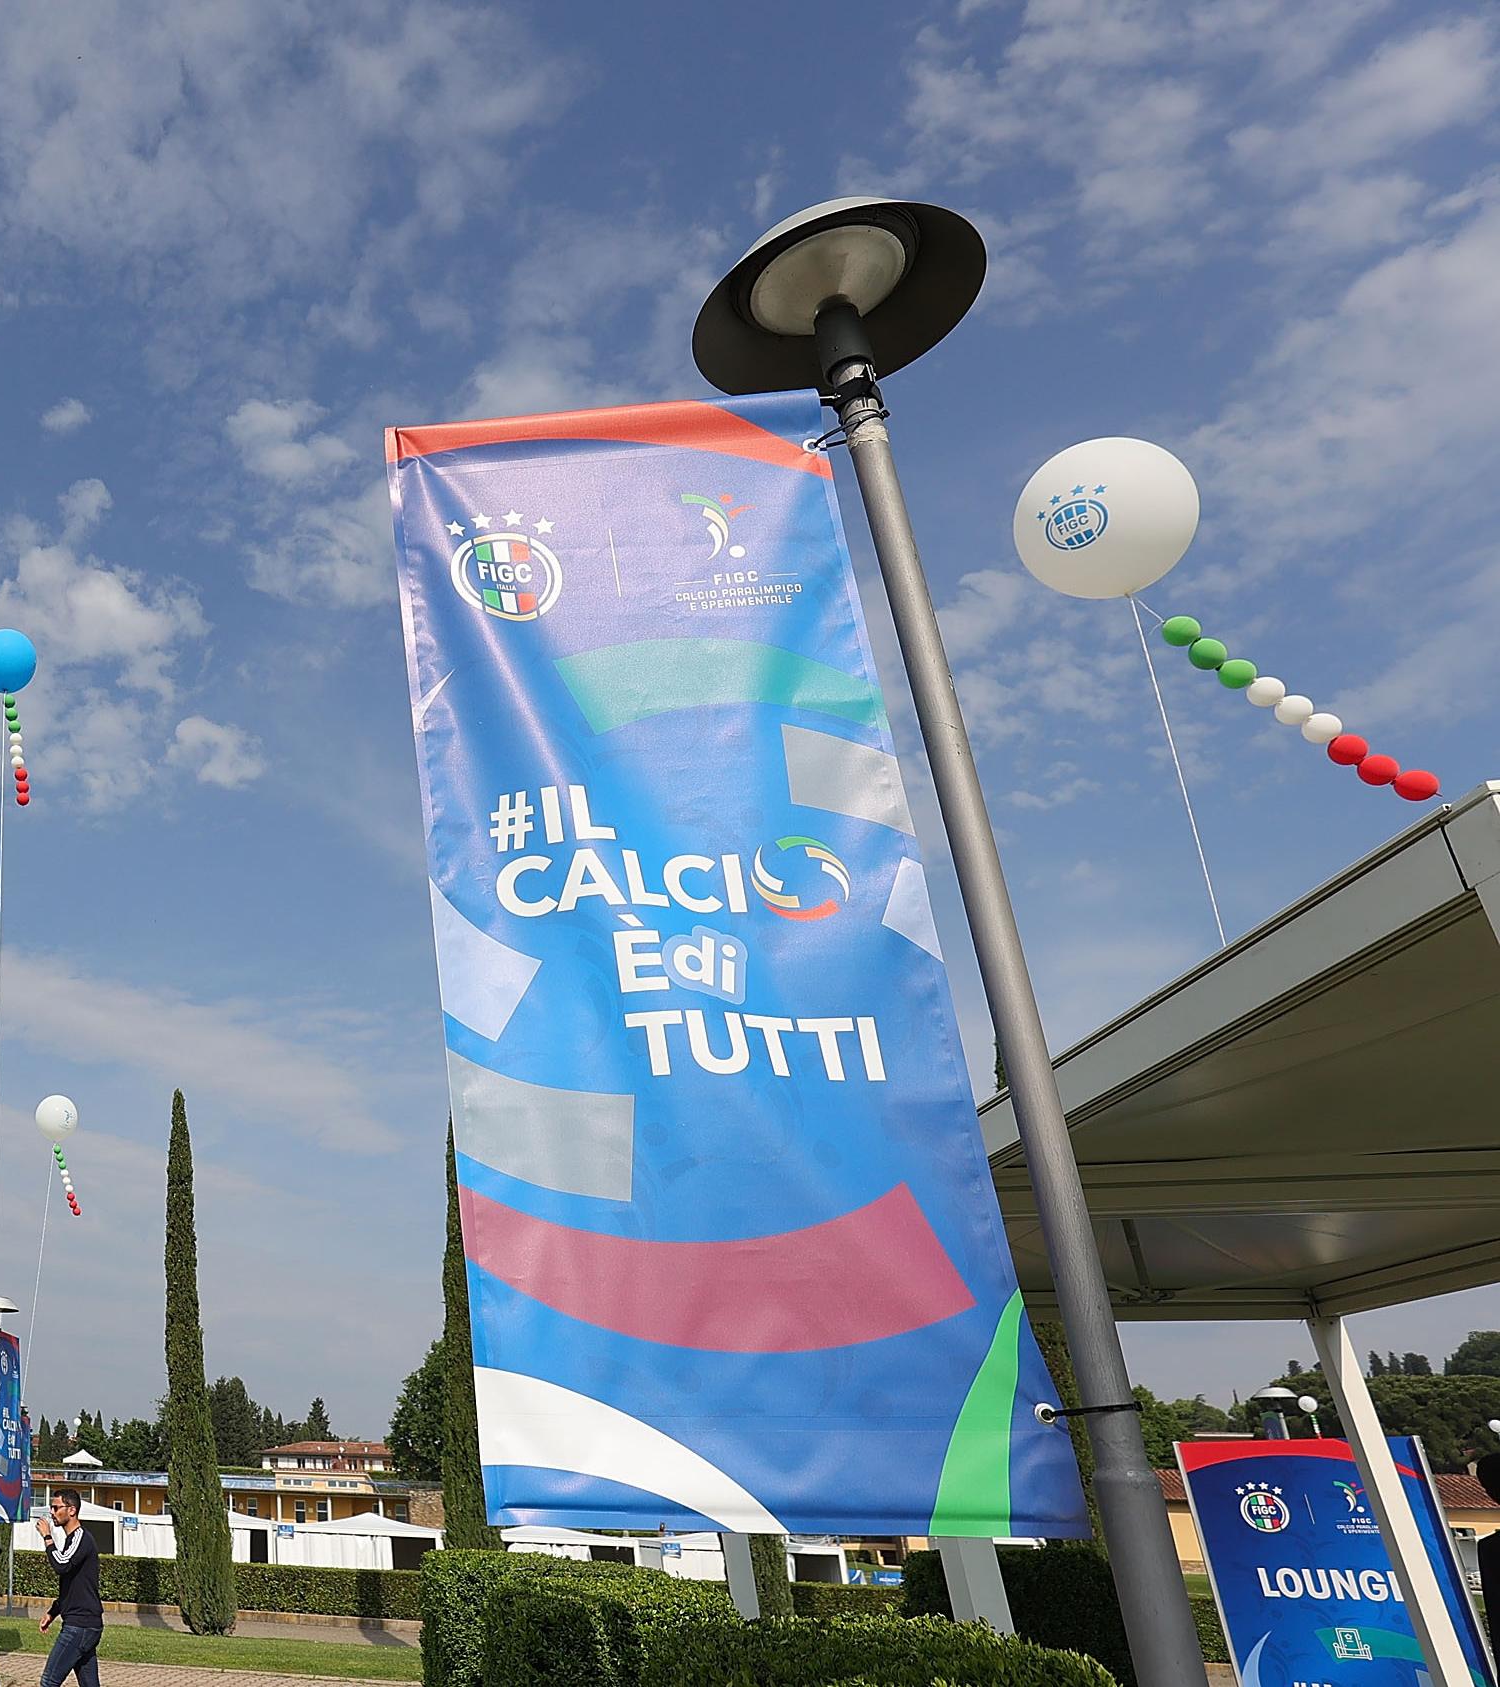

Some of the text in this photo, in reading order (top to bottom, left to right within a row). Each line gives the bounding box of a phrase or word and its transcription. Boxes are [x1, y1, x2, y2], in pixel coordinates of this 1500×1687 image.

[1057, 515, 1089, 535] FIGC
[477, 562, 533, 583] FIGC
[713, 571, 759, 586] FIGC
[496, 583, 517, 591] ITALIA
[675, 583, 803, 602] CALCIO PARALIMPICO
[690, 594, 793, 611] E SPERIMENTALE
[488, 784, 617, 853] #IL
[612, 913, 739, 995] È di
[623, 1009, 888, 1082] TUTTI
[1251, 1505, 1277, 1516] FIGC
